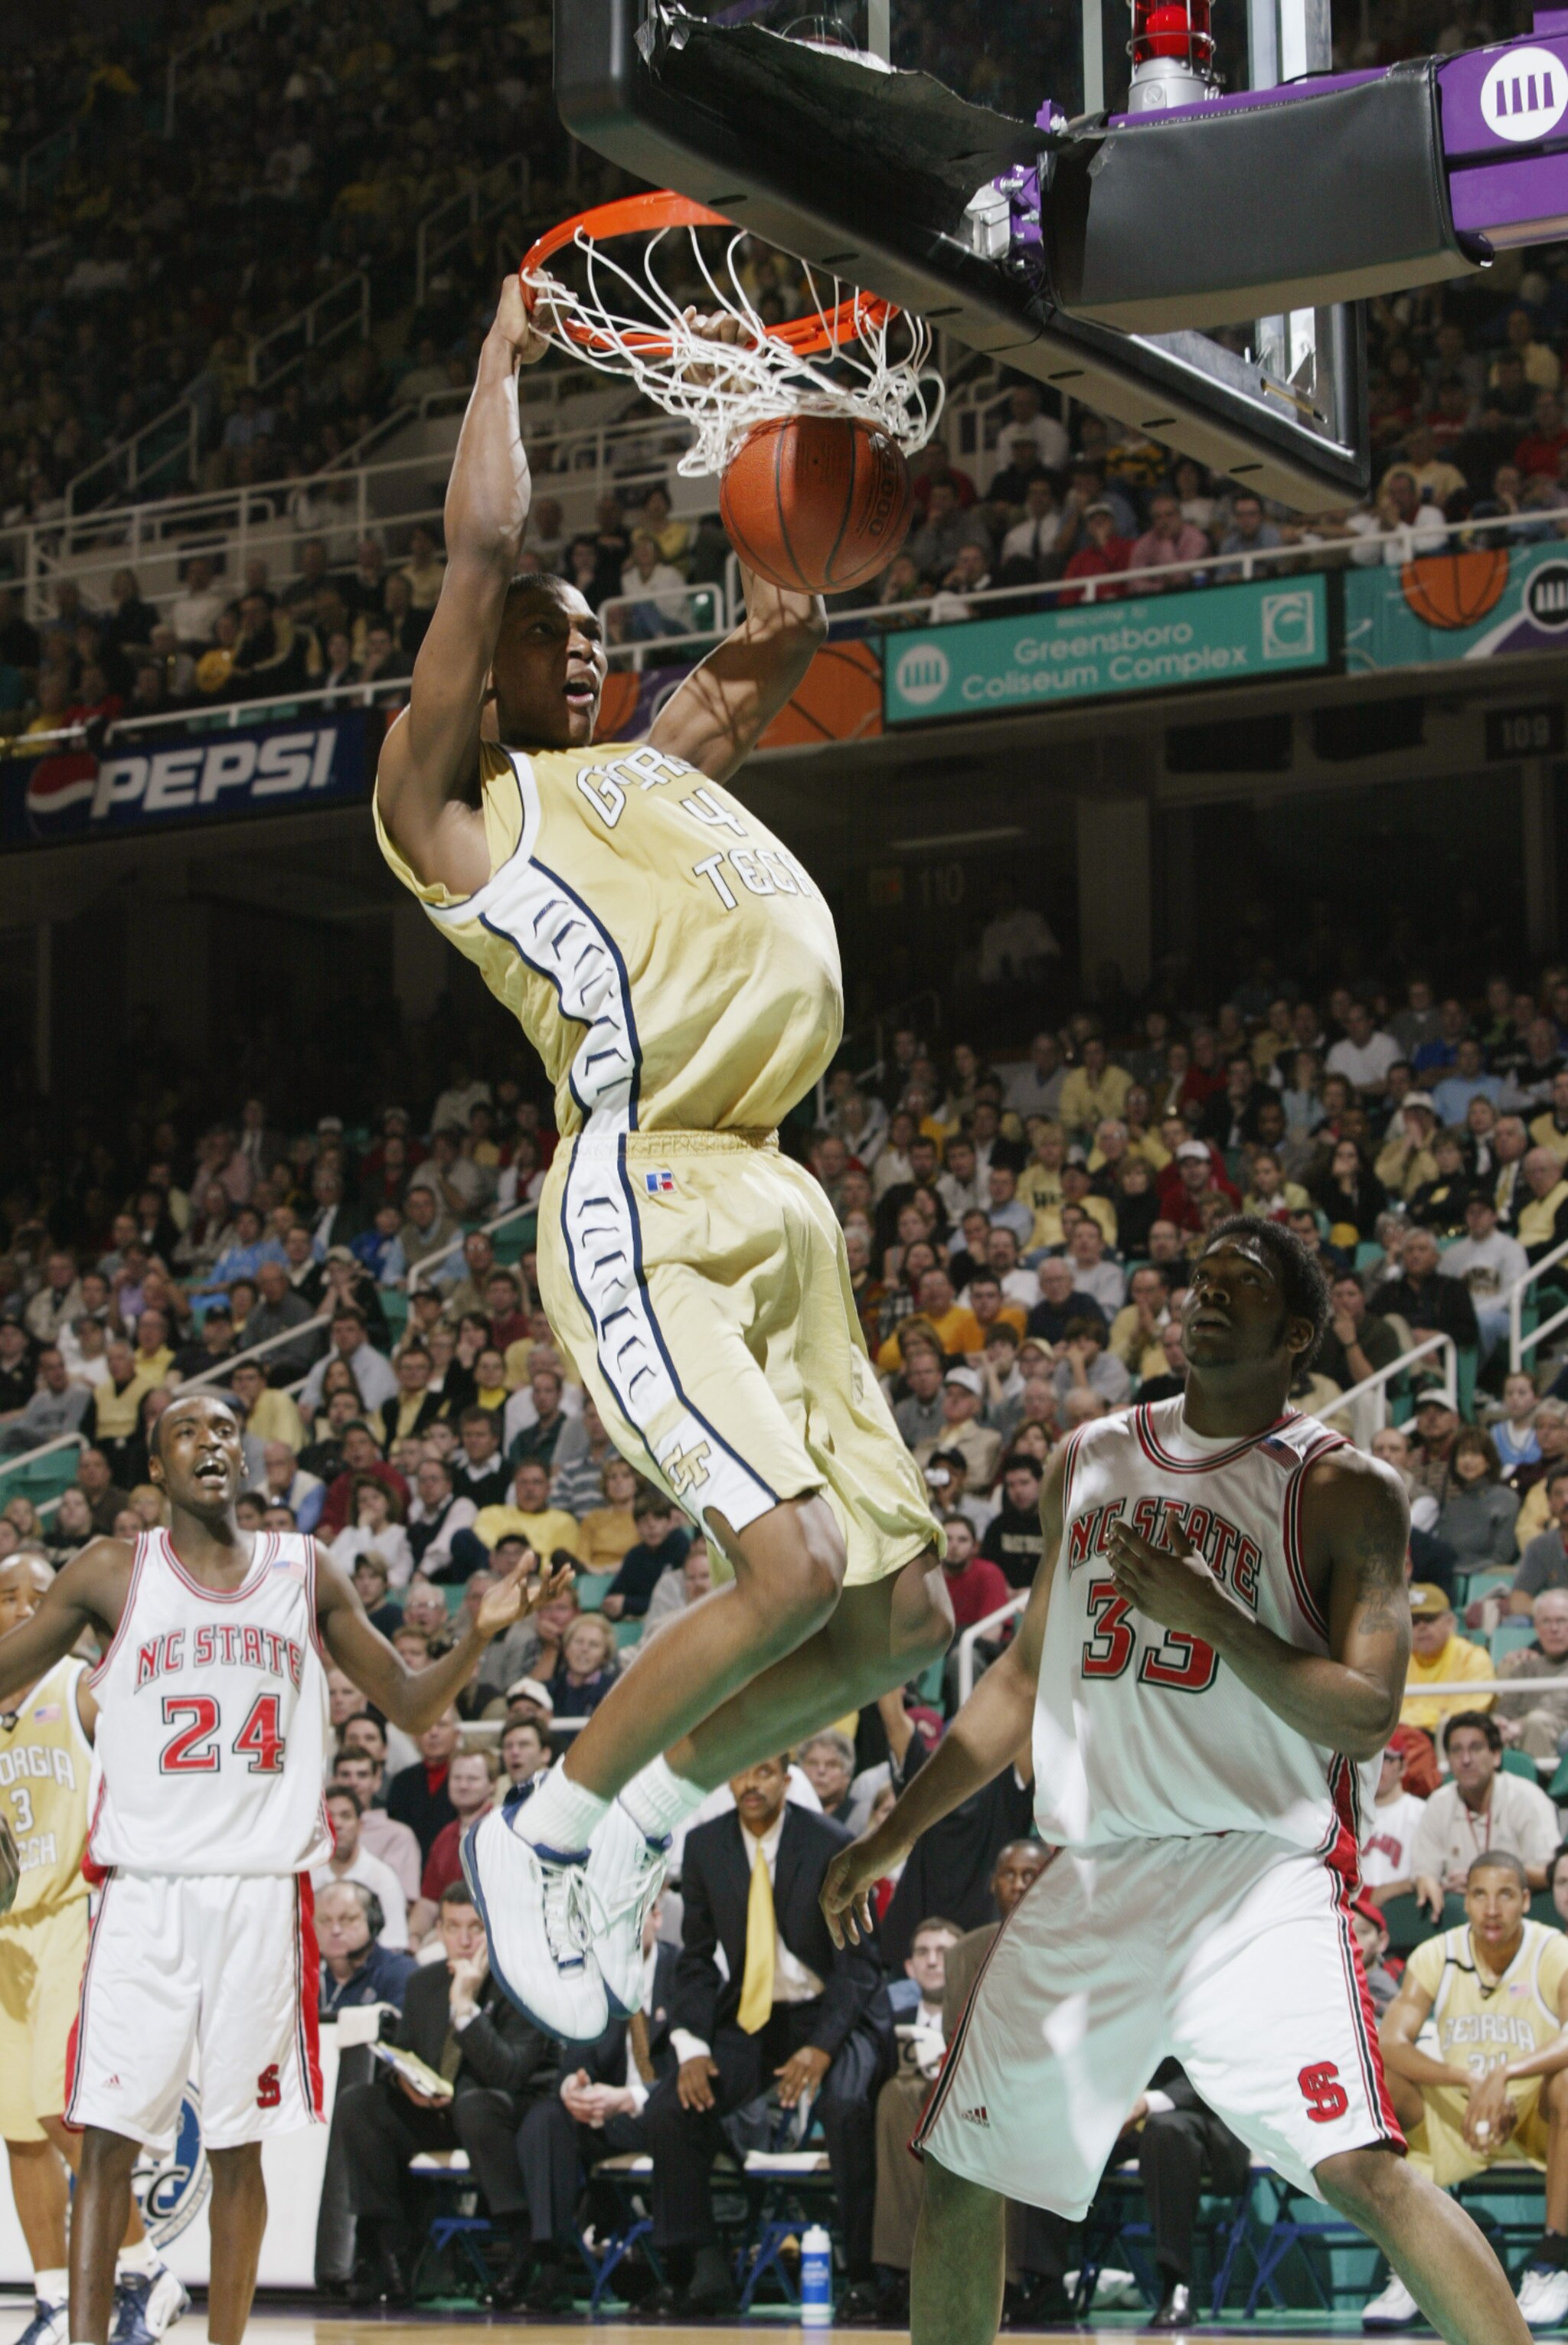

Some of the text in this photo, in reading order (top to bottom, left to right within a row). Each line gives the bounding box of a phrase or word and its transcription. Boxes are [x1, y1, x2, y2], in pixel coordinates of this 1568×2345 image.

[962, 645, 1247, 701] Coliseum Complex
[1014, 622, 1194, 665] Greensboro
[90, 727, 337, 820] PEPSI
[678, 787, 748, 836] 4
[692, 849, 821, 911] TECH
[1131, 1495, 1262, 1612] STATE
[133, 1623, 305, 1698] NC STATE
[1081, 1579, 1220, 1694] 33
[159, 1693, 286, 1775] 24
[10, 1787, 34, 1834] 3
[1443, 2012, 1537, 2053] GEORGIA
